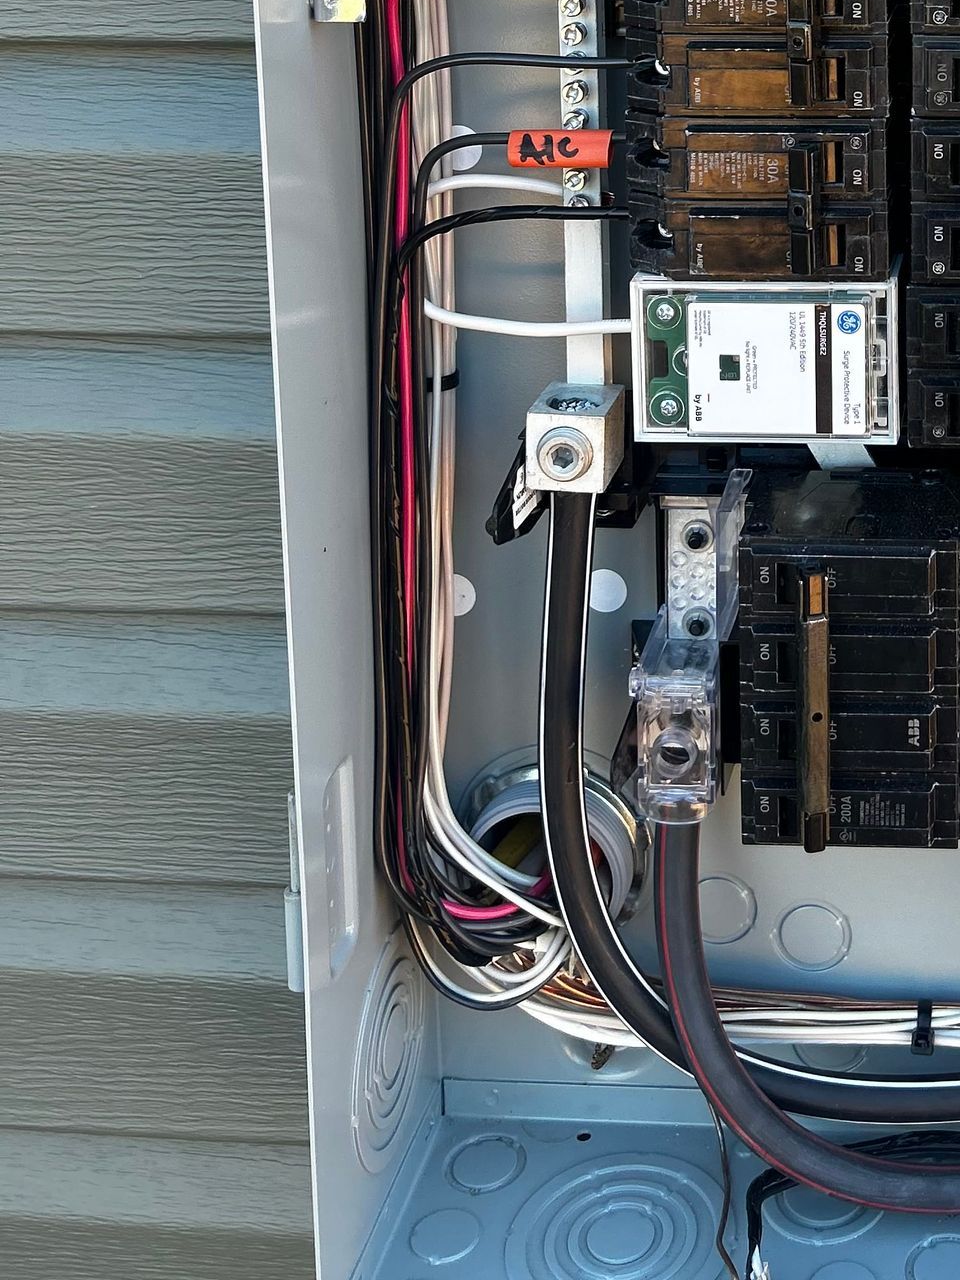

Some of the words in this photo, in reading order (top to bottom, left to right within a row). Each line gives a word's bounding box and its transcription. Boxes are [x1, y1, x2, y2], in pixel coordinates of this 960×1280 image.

[852, 3, 861, 19] ON
[938, 64, 948, 81] ON
[693, 78, 700, 87] by
[853, 91, 862, 107] ON
[934, 144, 944, 159] ON
[767, 158, 779, 183] 30A
[852, 170, 862, 185] ON
[934, 226, 944, 241] ON
[854, 257, 863, 272] ON
[799, 312, 805, 320] UL
[935, 313, 944, 328] ON
[842, 351, 850, 369] Surge
[694, 395, 702, 404] by
[935, 392, 944, 407] ON
[760, 566, 770, 584] ON
[828, 568, 837, 589] OFF
[760, 643, 770, 661] ON
[760, 719, 770, 736] ON
[908, 719, 921, 746] ABB
[760, 796, 770, 813] ON
[841, 796, 851, 823] 200A
